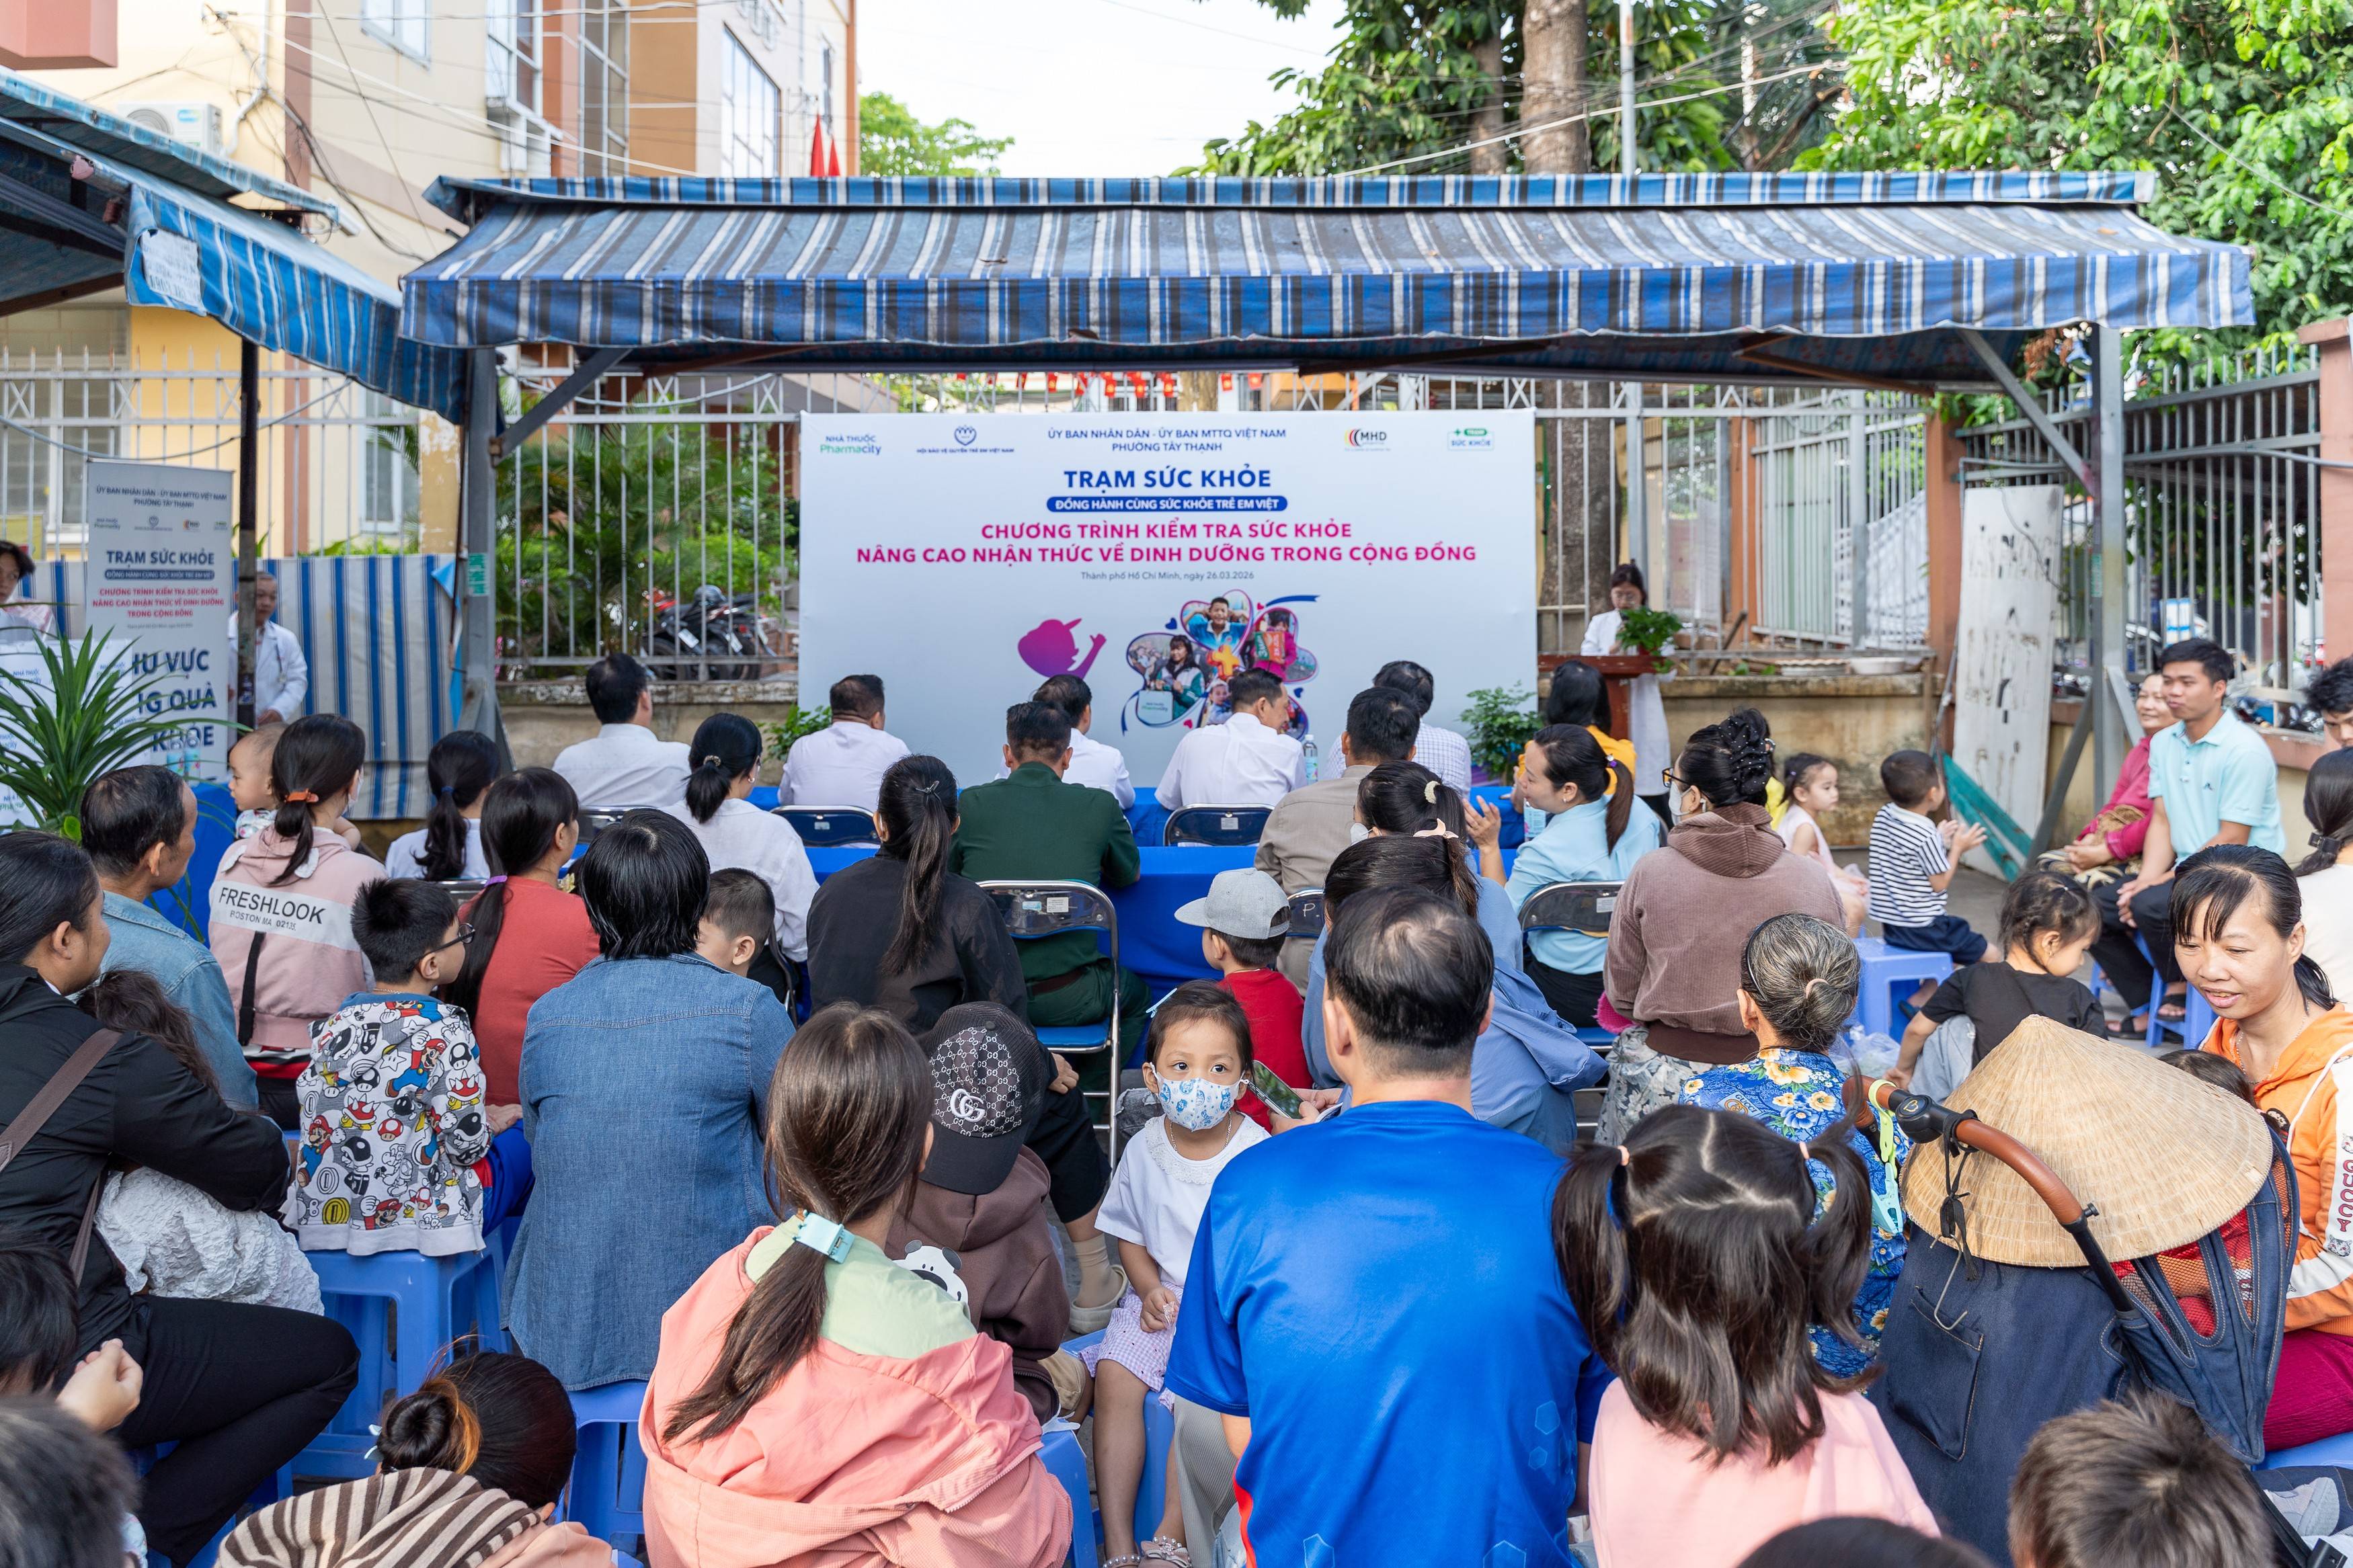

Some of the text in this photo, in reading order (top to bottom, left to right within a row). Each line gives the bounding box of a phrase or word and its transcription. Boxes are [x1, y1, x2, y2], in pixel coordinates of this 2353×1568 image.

[826, 434, 844, 442] NHÀ
[1048, 427, 1062, 438] ỦY
[1066, 430, 1088, 438] BAN
[1091, 428, 1123, 438] NHÂN
[1126, 427, 1150, 438] DÂN
[1158, 427, 1172, 438] ỦY
[1176, 429, 1198, 438] BAN
[1201, 429, 1232, 439] MTTQ
[1235, 427, 1257, 440] VIỆT
[1261, 429, 1285, 438] NAM
[1361, 431, 1387, 441] MHD
[820, 443, 882, 455] Pharmacity
[1112, 442, 1222, 454] PHƯỜNG TÂY THẠNH
[1064, 464, 1271, 493] TRẠM SỨC KHỎE
[1055, 497, 1279, 511] ĐỒNG HÀNH CÙNG SỨC KHỎE TRẺ EM VIỆT
[982, 517, 1351, 538] CHƯƠNG TRÌNH KIỂM TRA SỨC KHỎE
[106, 548, 214, 568] TRẠM SỨC KHỎE
[857, 541, 1476, 567] NÂNG CAO NHẬN THỨC VỀ DINH DƯỠNG TRONG CỘNG ĐỒNG
[1081, 571, 1254, 583] Thành phố Hồ Chí Minh, ngày 26.03.2026
[218, 887, 327, 924] FRESHLOOK
[1735, 1094, 1757, 1113] GUCCI
